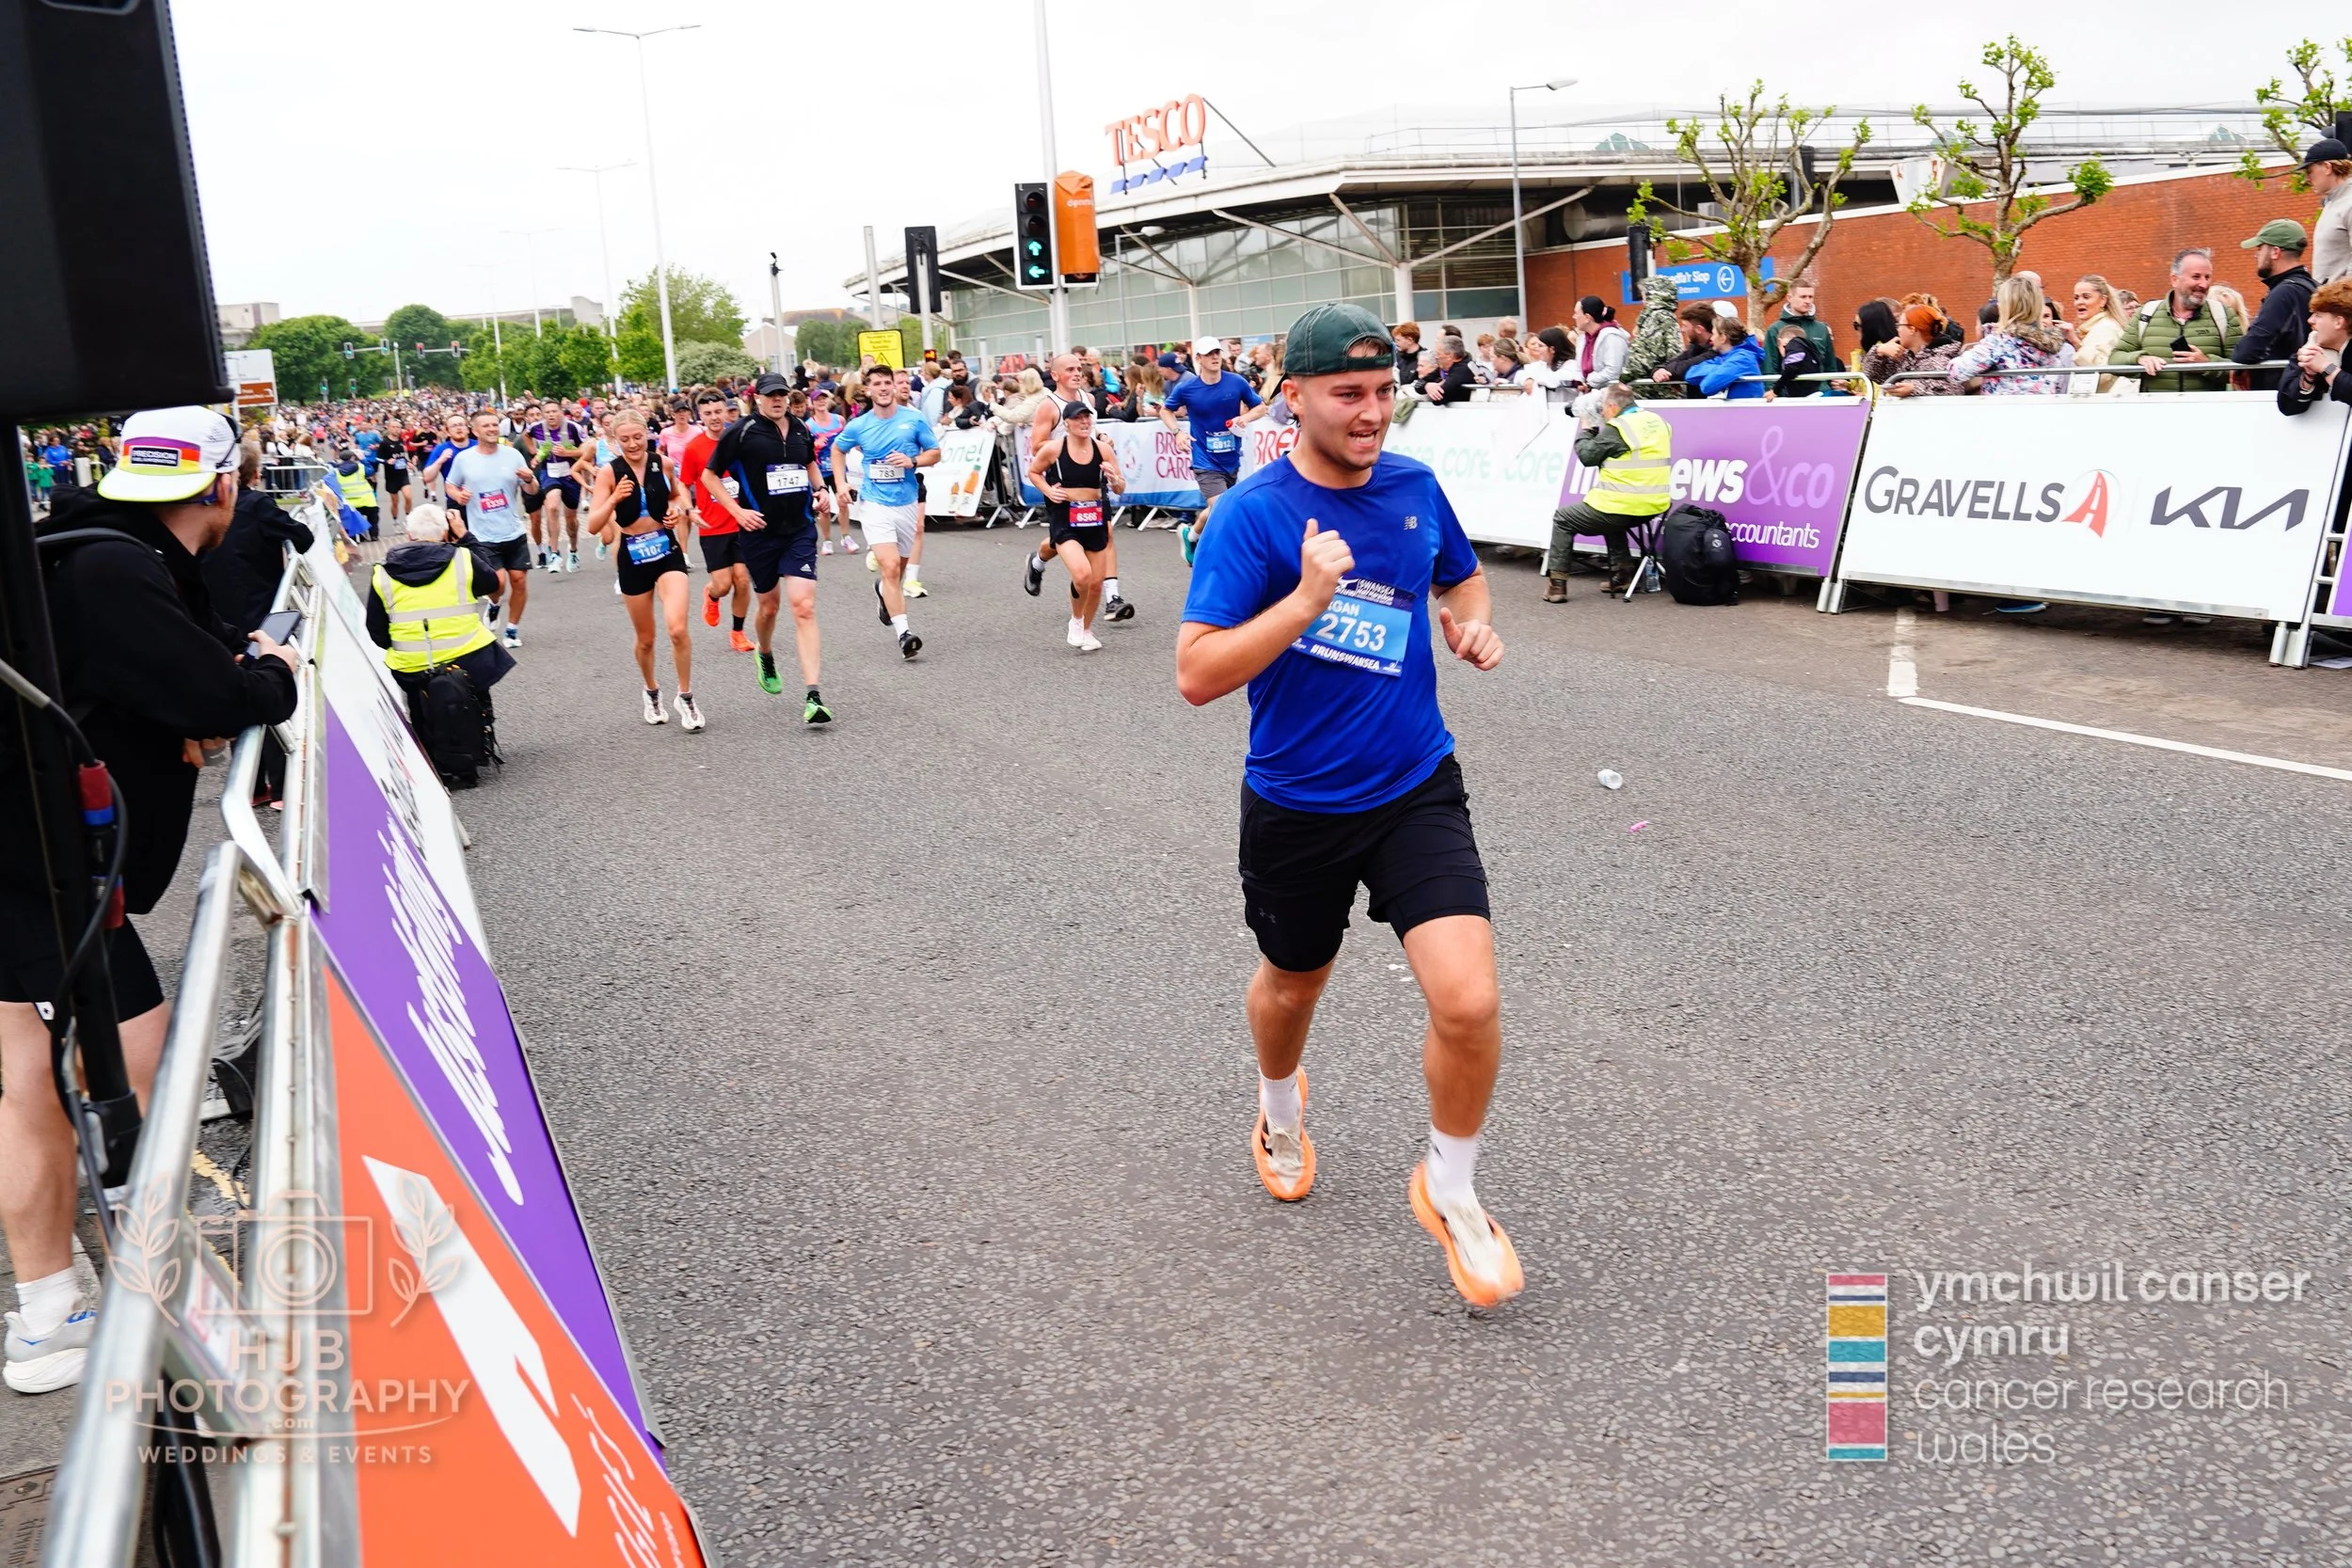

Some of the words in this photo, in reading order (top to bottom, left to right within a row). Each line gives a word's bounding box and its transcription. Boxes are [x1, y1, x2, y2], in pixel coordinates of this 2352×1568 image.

[1104, 93, 1206, 167] TESCO
[132, 450, 178, 461] PRECISION
[777, 476, 800, 487] 1747
[878, 469, 896, 478] 783
[1864, 465, 2066, 523] GRAVELLS
[2150, 485, 2310, 531] KIA
[1724, 520, 1821, 549] ccountants
[638, 543, 663, 558] 1107
[1315, 612, 1388, 652] 2753
[1310, 643, 1381, 671] #RUNSWANSEA
